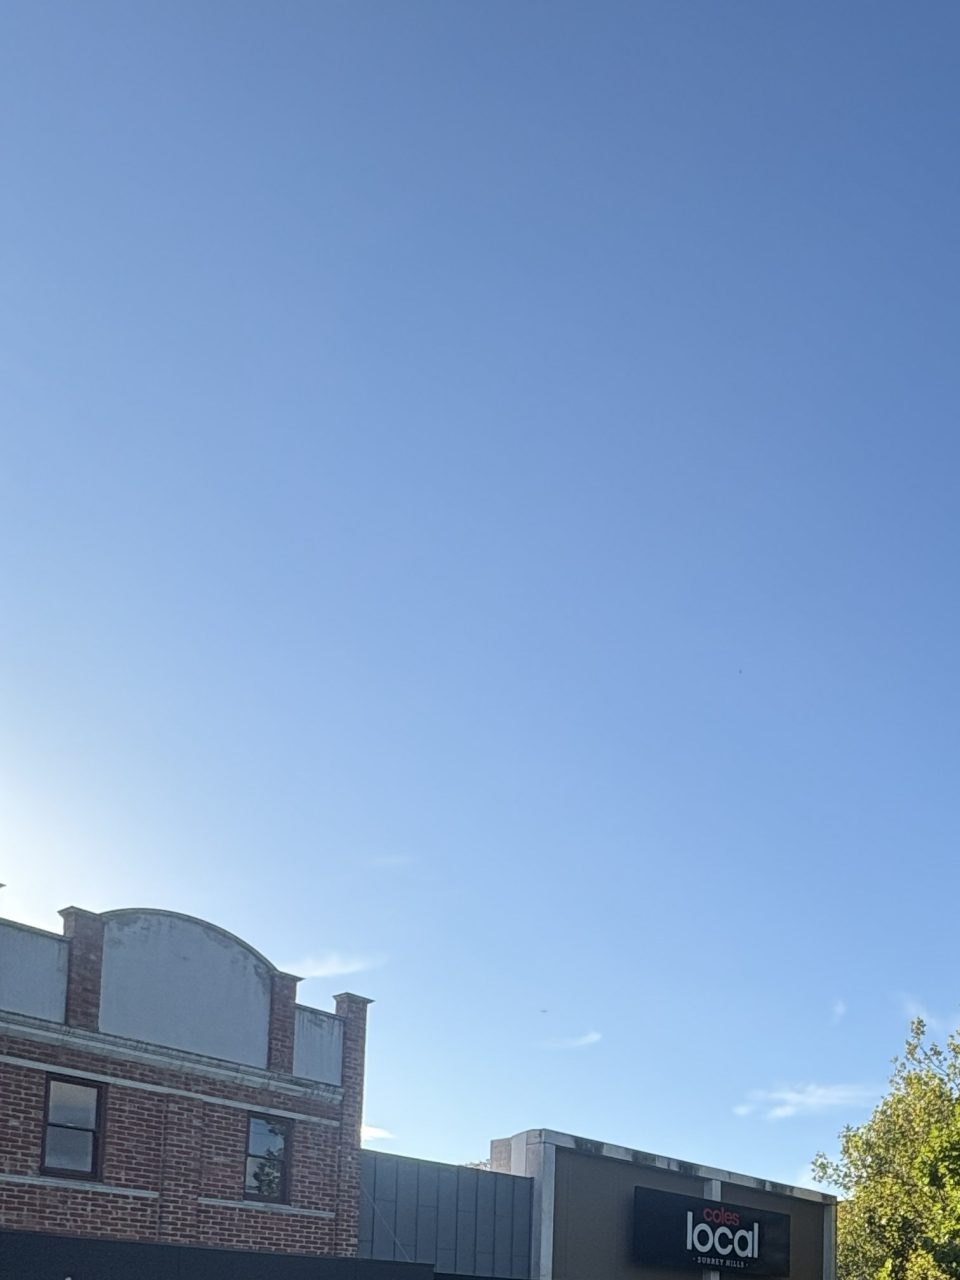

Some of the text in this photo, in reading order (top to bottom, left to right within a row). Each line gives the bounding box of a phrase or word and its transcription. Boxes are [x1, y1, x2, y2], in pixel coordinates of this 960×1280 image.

[703, 1207, 739, 1226] coles
[687, 1211, 759, 1258] local
[697, 1256, 744, 1268] SURREY HILLS
